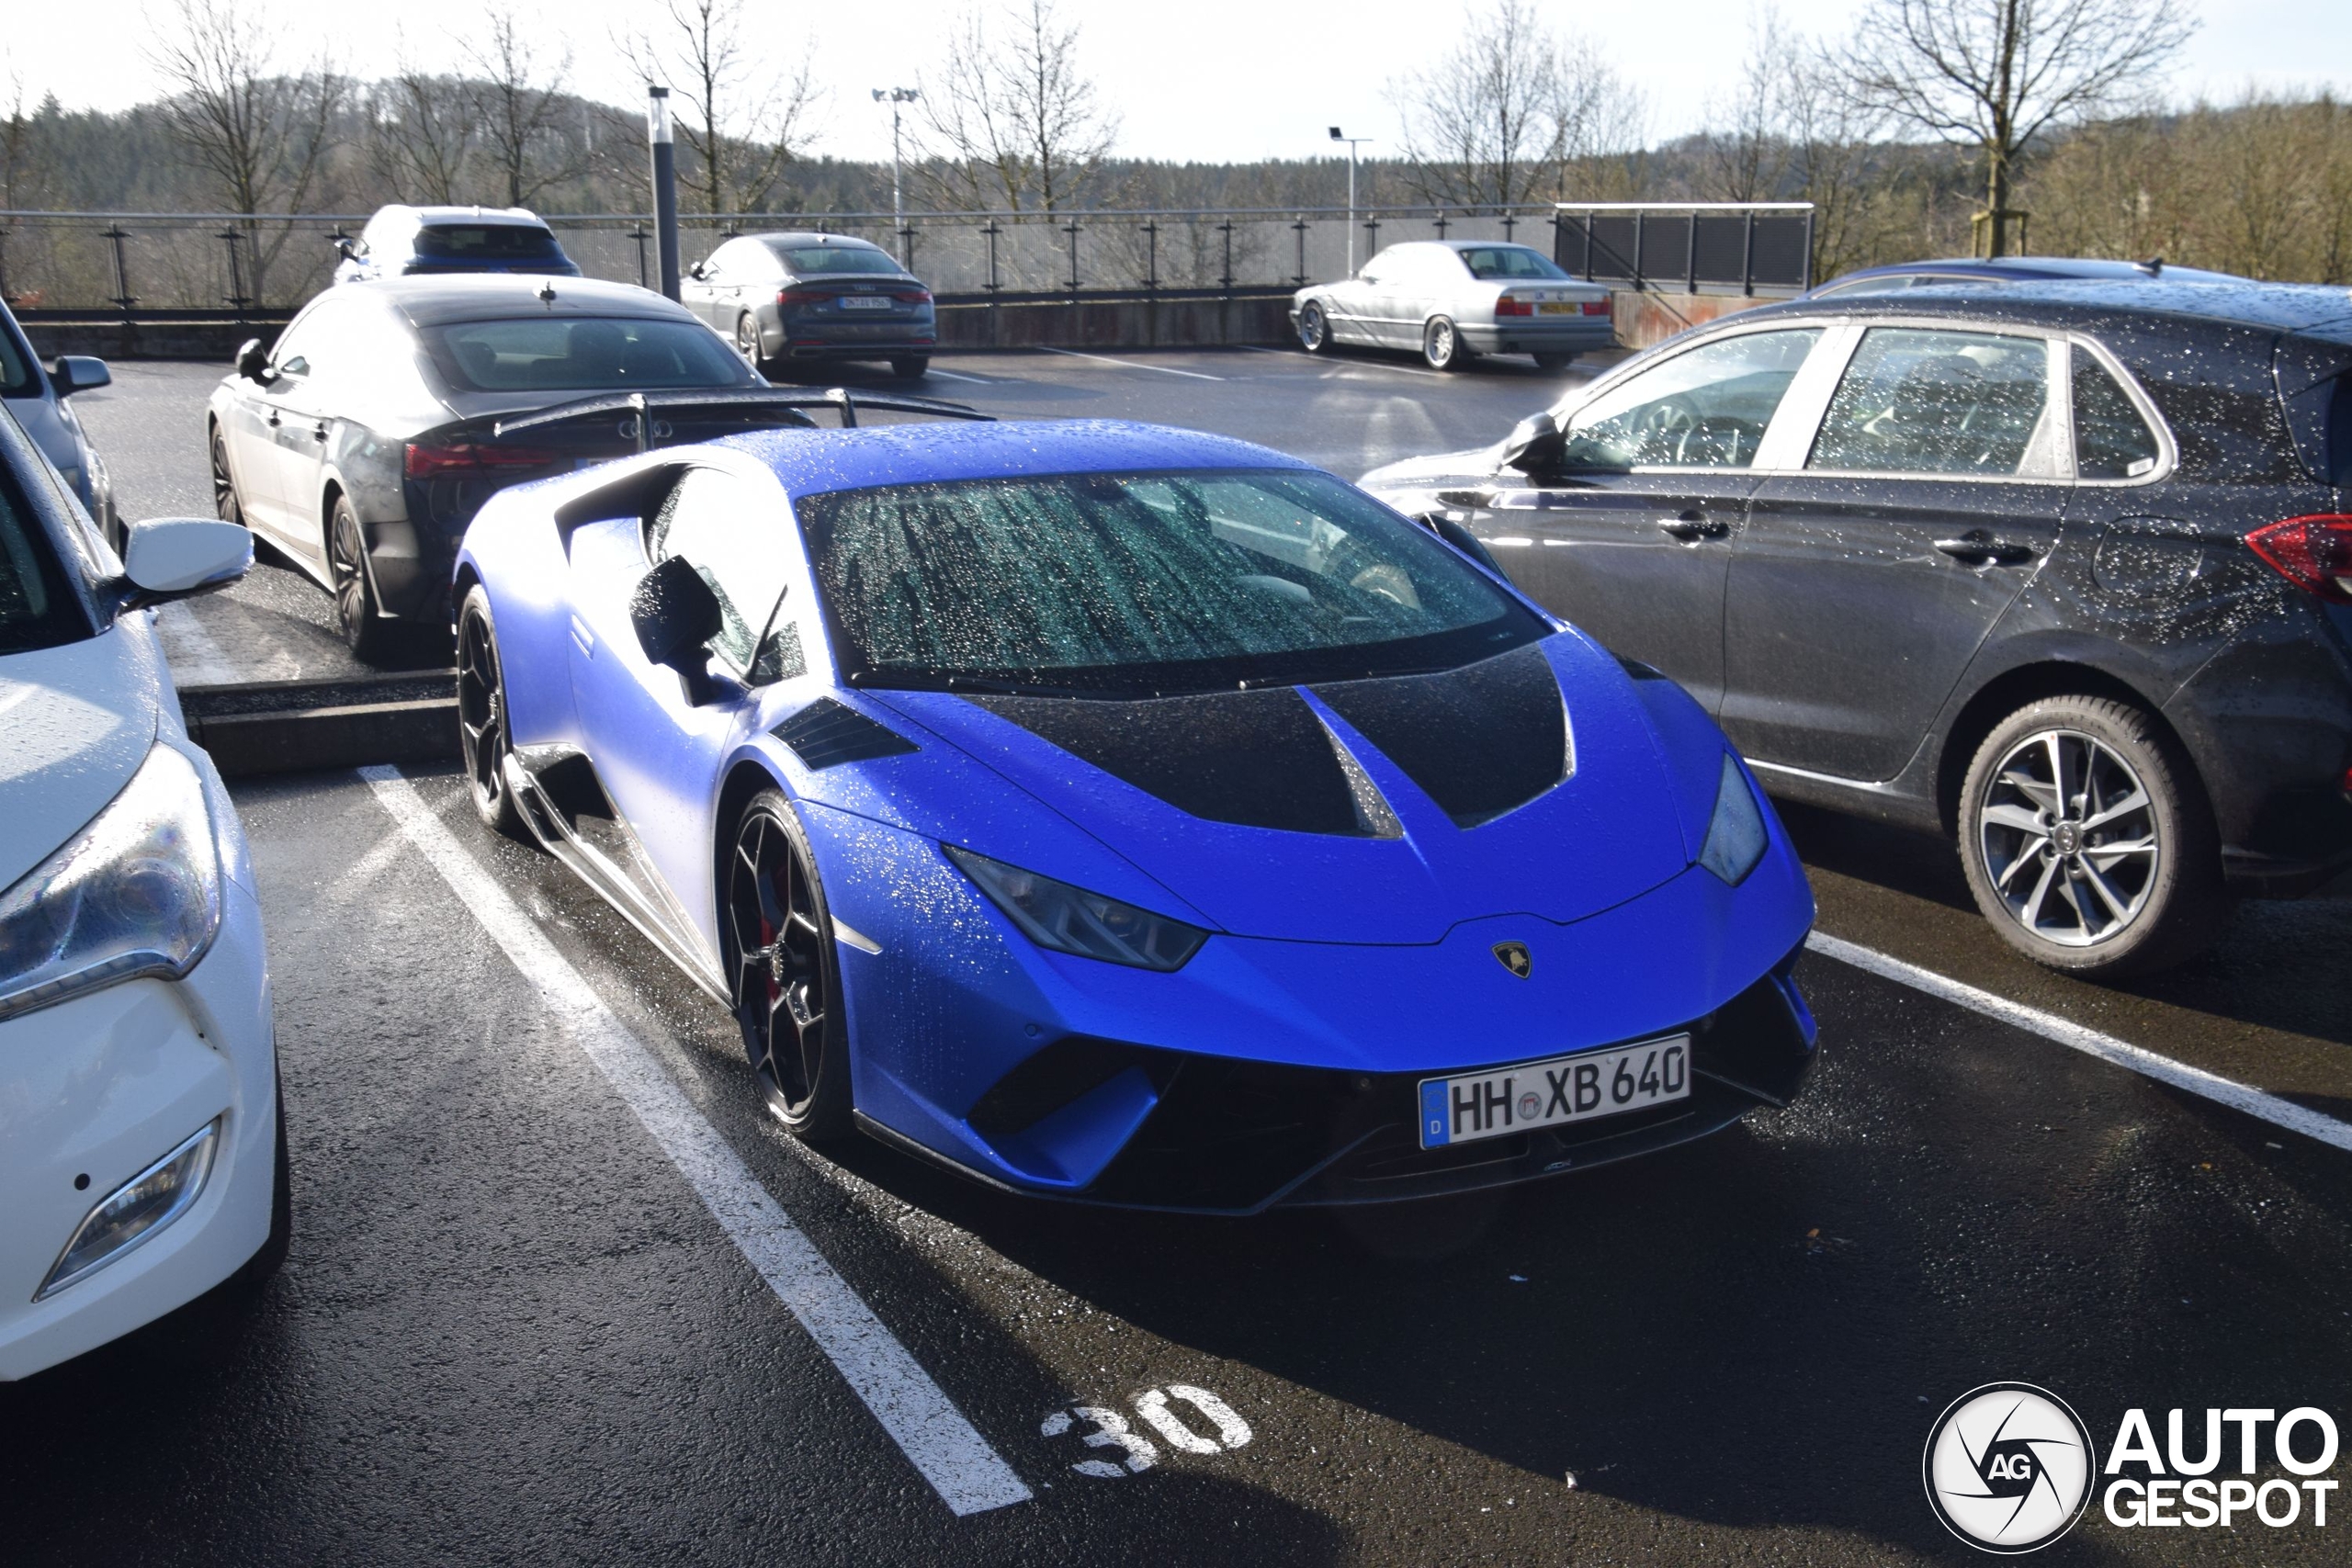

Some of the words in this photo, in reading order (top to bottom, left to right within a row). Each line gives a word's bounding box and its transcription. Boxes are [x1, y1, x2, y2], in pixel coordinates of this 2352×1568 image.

[1430, 1120, 1441, 1134] D
[1452, 1077, 1512, 1134] HH
[1545, 1063, 1601, 1119] XB
[1611, 1045, 1684, 1104] 640
[1041, 1384, 1252, 1478] 30
